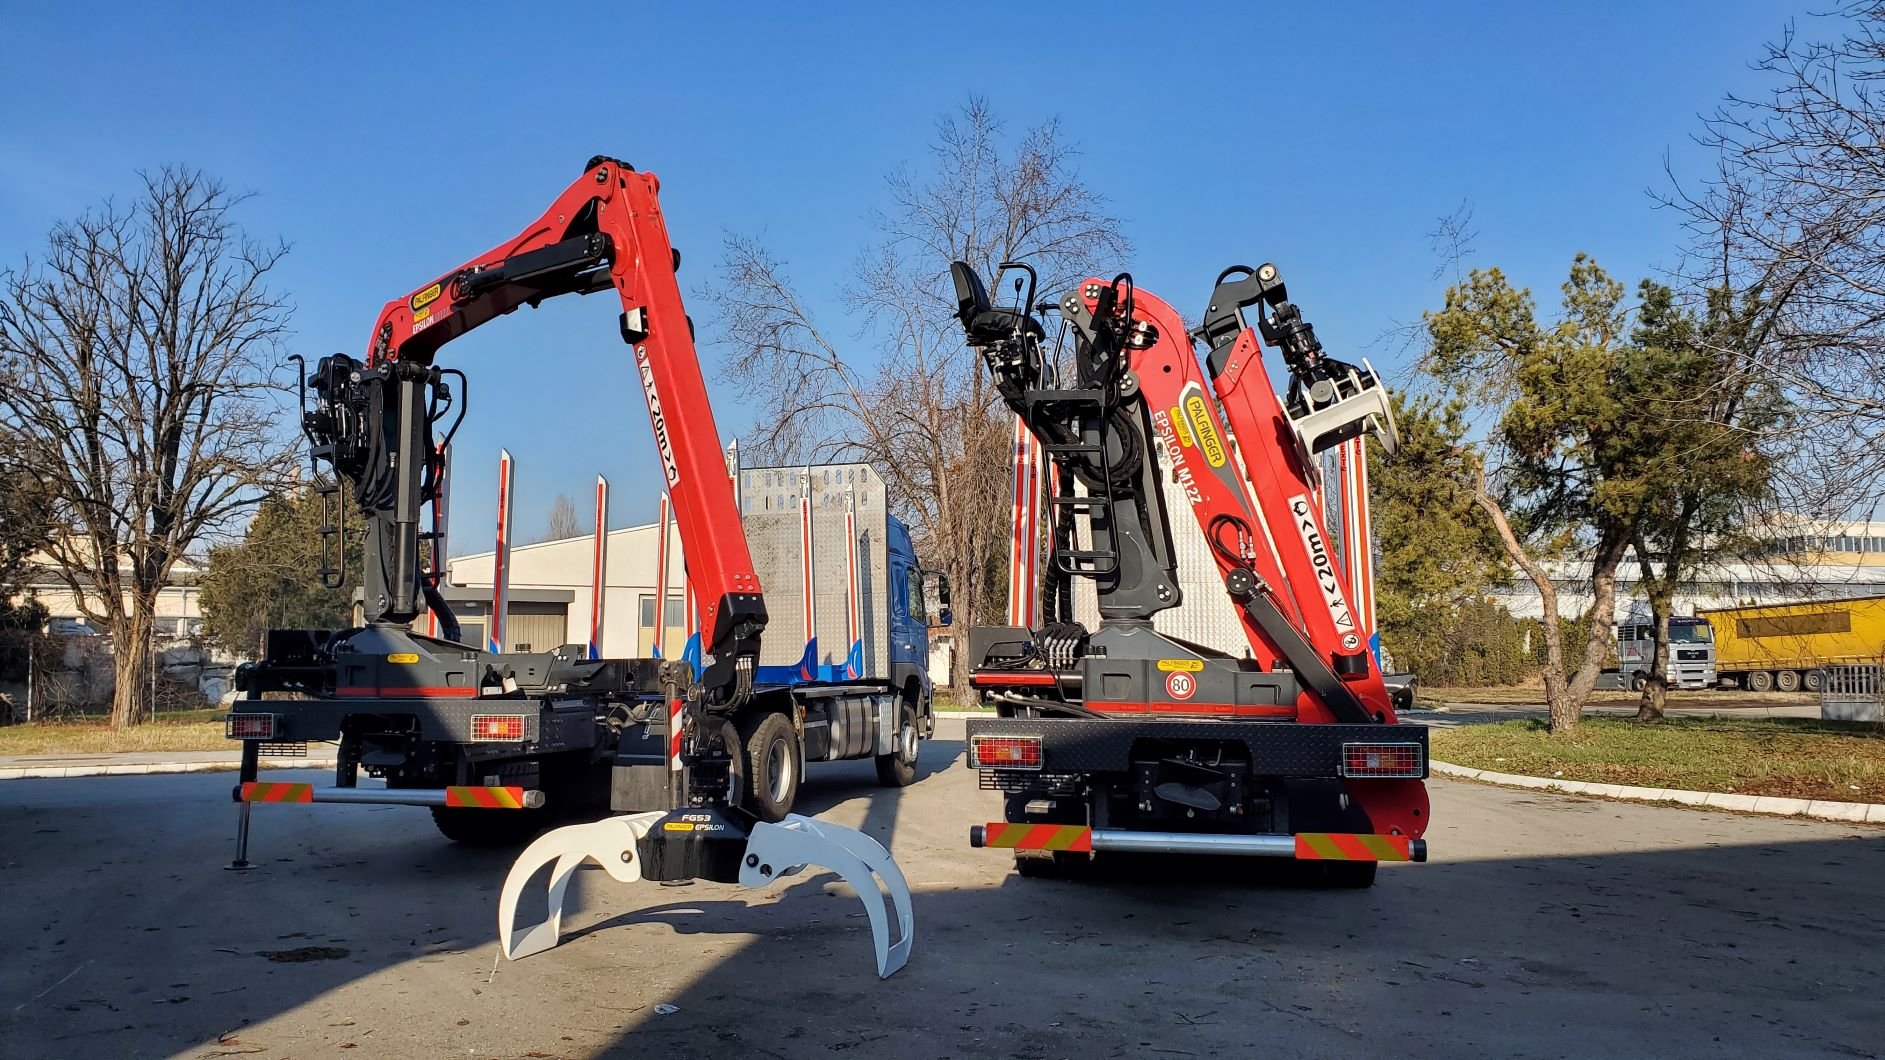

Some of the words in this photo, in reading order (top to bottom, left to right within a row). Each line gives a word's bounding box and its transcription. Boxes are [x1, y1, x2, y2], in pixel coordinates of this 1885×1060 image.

[412, 315, 434, 335] EPSILON
[1190, 400, 1222, 463] PALFINGER
[1154, 410, 1185, 466] EPSILON
[1178, 467, 1203, 505] M12Z
[1173, 678, 1190, 692] 80
[681, 814, 711, 822] FG53
